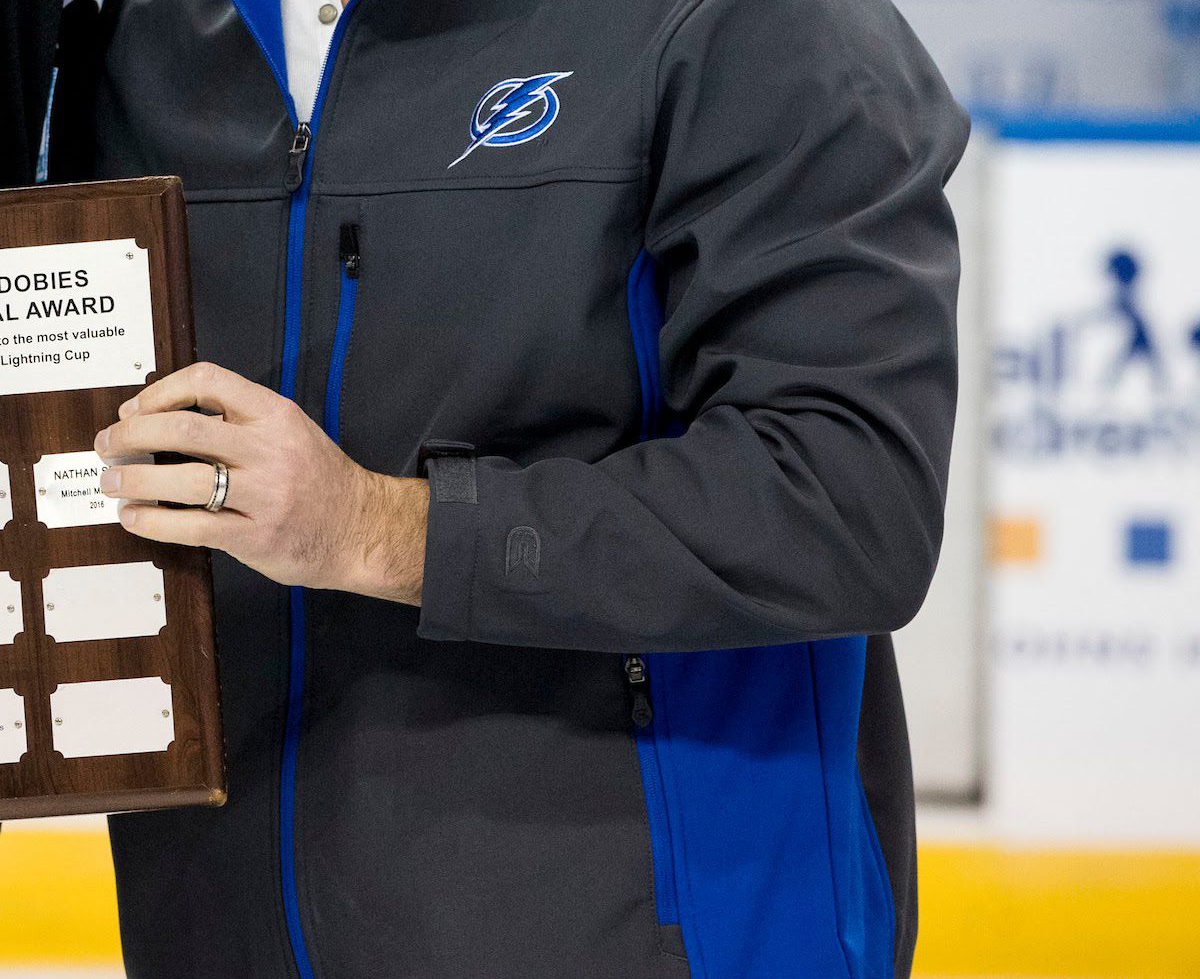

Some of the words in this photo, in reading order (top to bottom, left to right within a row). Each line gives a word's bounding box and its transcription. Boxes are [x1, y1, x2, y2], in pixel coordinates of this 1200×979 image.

[26, 296, 115, 320] AWARD
[13, 334, 33, 344] the
[36, 332, 68, 343] most
[72, 326, 126, 340] valuable
[0, 350, 61, 368] Lightning
[64, 349, 90, 362] Cup
[54, 468, 98, 480] NATHAN
[61, 488, 91, 498] Mitchell
